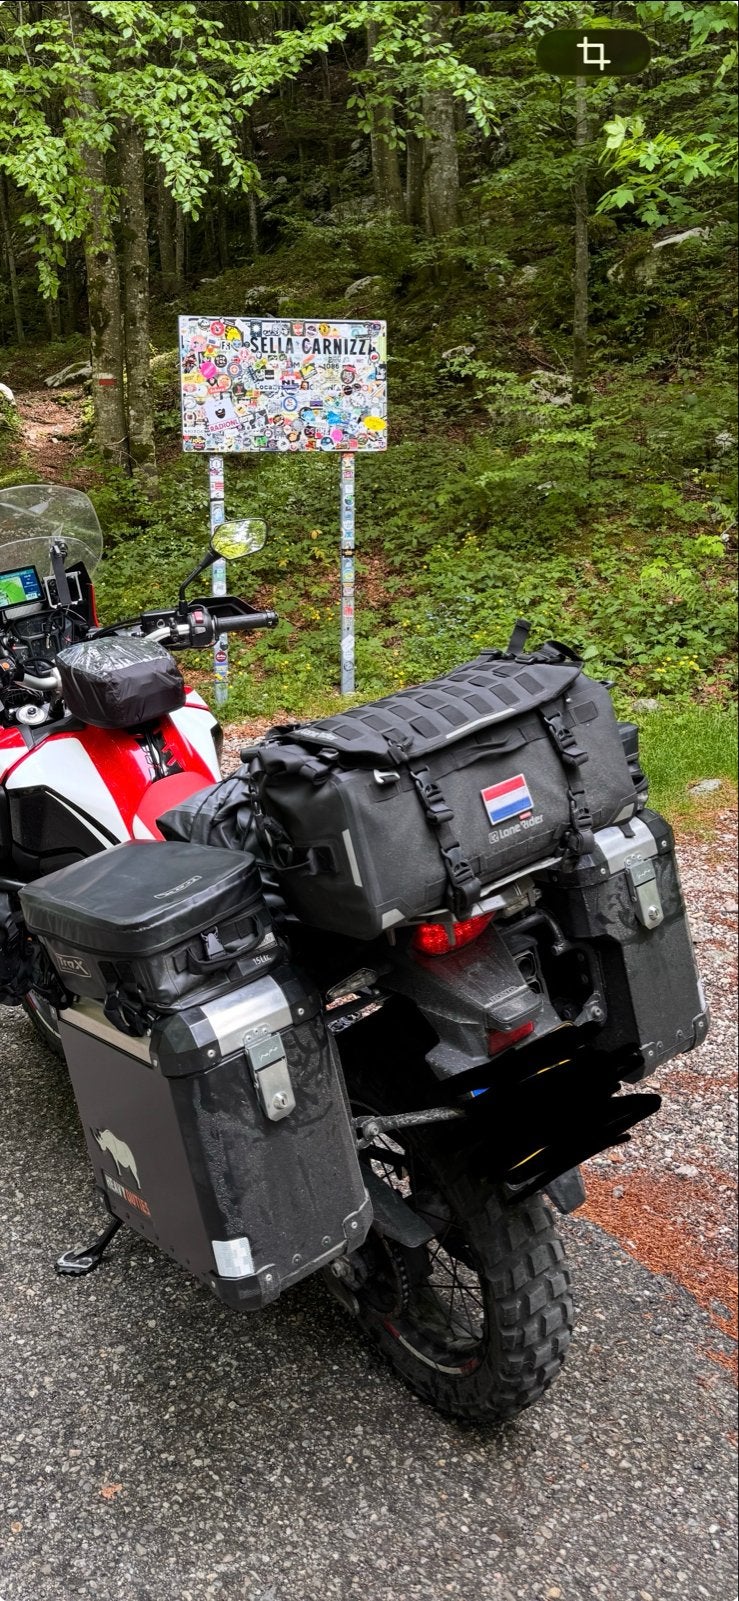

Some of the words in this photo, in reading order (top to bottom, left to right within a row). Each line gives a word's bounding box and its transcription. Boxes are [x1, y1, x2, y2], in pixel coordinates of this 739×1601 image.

[250, 337, 294, 354] SELLA
[499, 823, 521, 839] Lone
[520, 814, 544, 829] Rider
